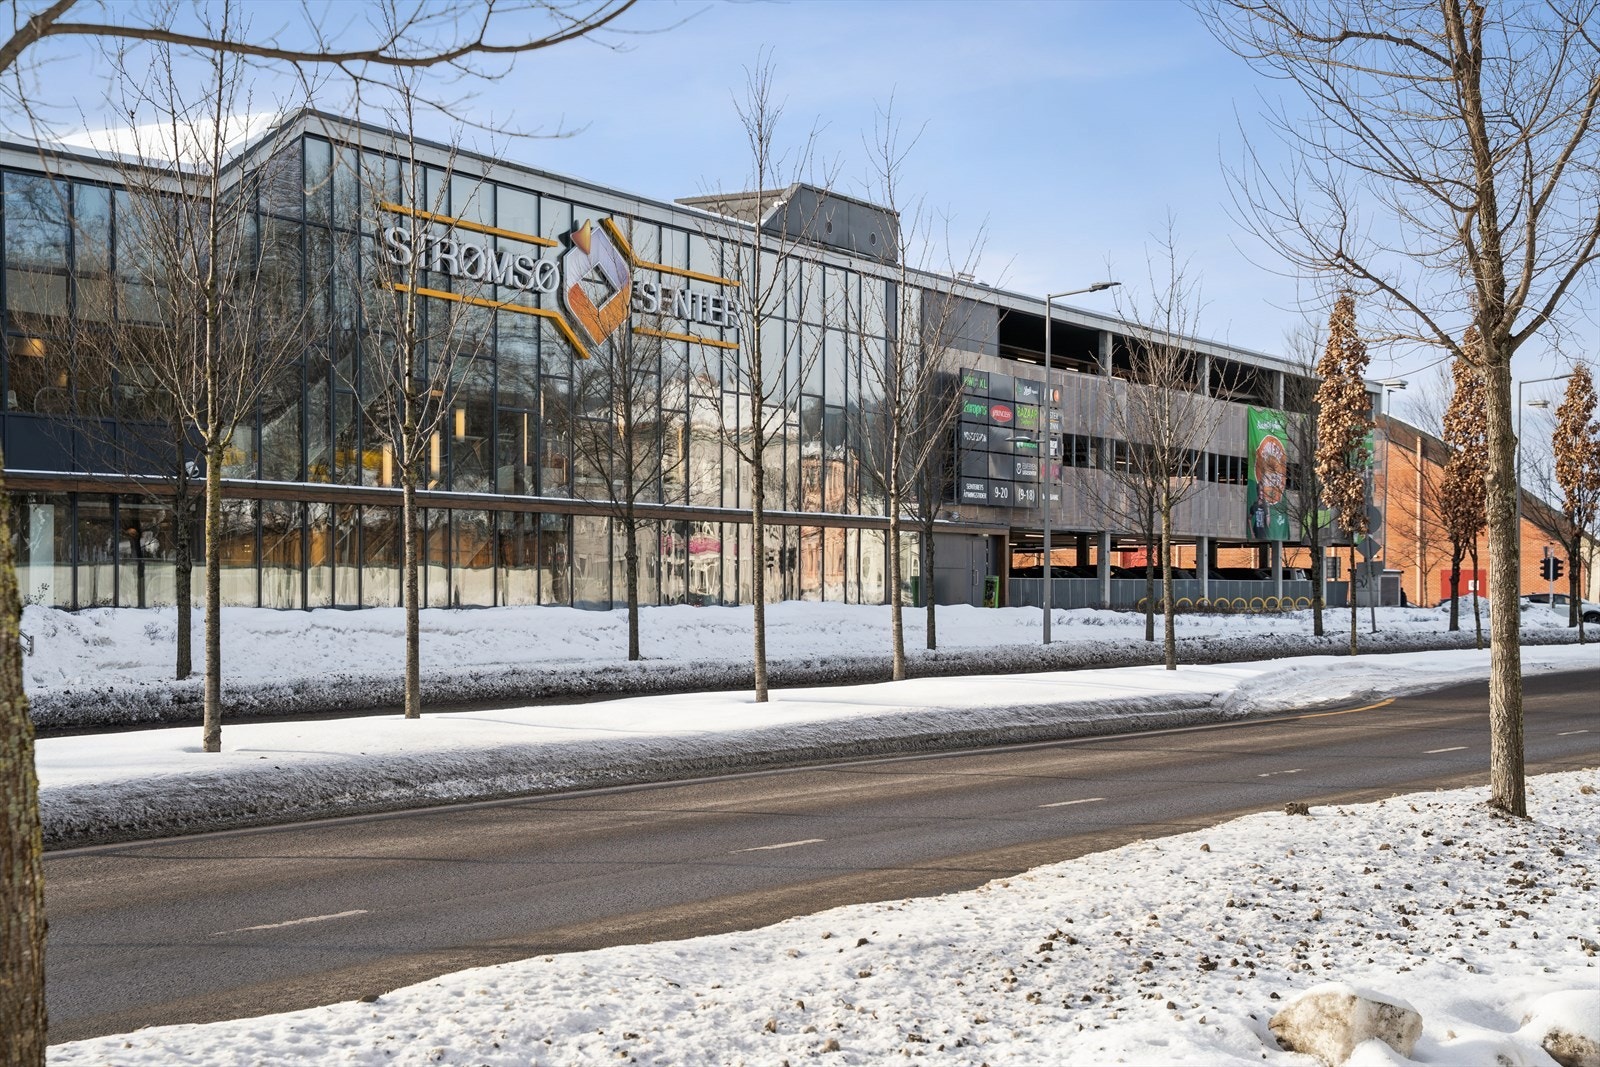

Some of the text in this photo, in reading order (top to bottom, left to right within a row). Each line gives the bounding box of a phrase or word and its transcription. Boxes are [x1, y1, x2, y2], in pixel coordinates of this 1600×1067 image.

[385, 226, 741, 328] STRØMSØ SENTER
[994, 486, 1009, 498] 9-20
[1018, 488, 1035, 502] (9-18)
